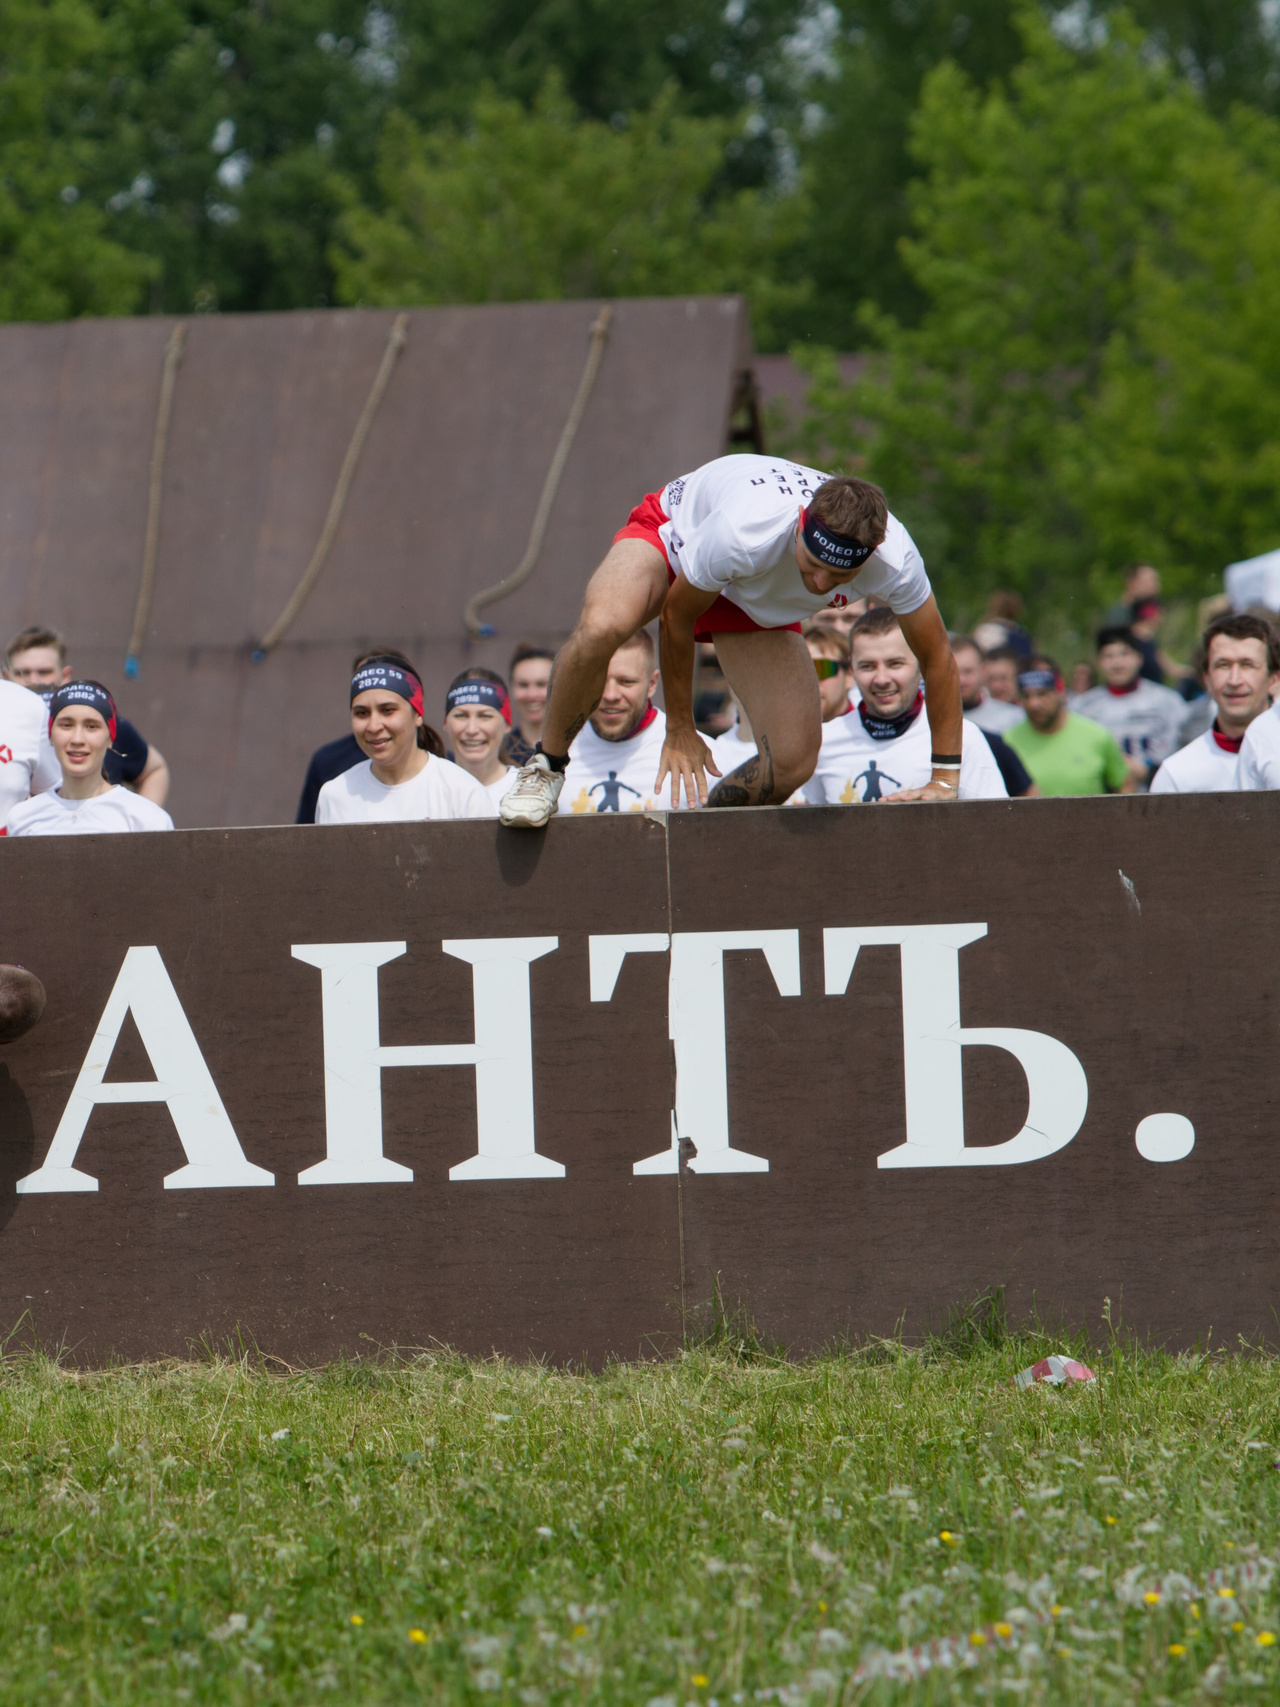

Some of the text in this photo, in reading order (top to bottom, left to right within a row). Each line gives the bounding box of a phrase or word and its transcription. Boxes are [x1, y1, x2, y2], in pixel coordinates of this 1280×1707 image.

[778, 486, 815, 498] ОН
[813, 530, 869, 557] РОДЕО 59
[820, 551, 852, 567] 2886
[352, 668, 403, 685] ОДЕО 59
[358, 677, 387, 689] 2874
